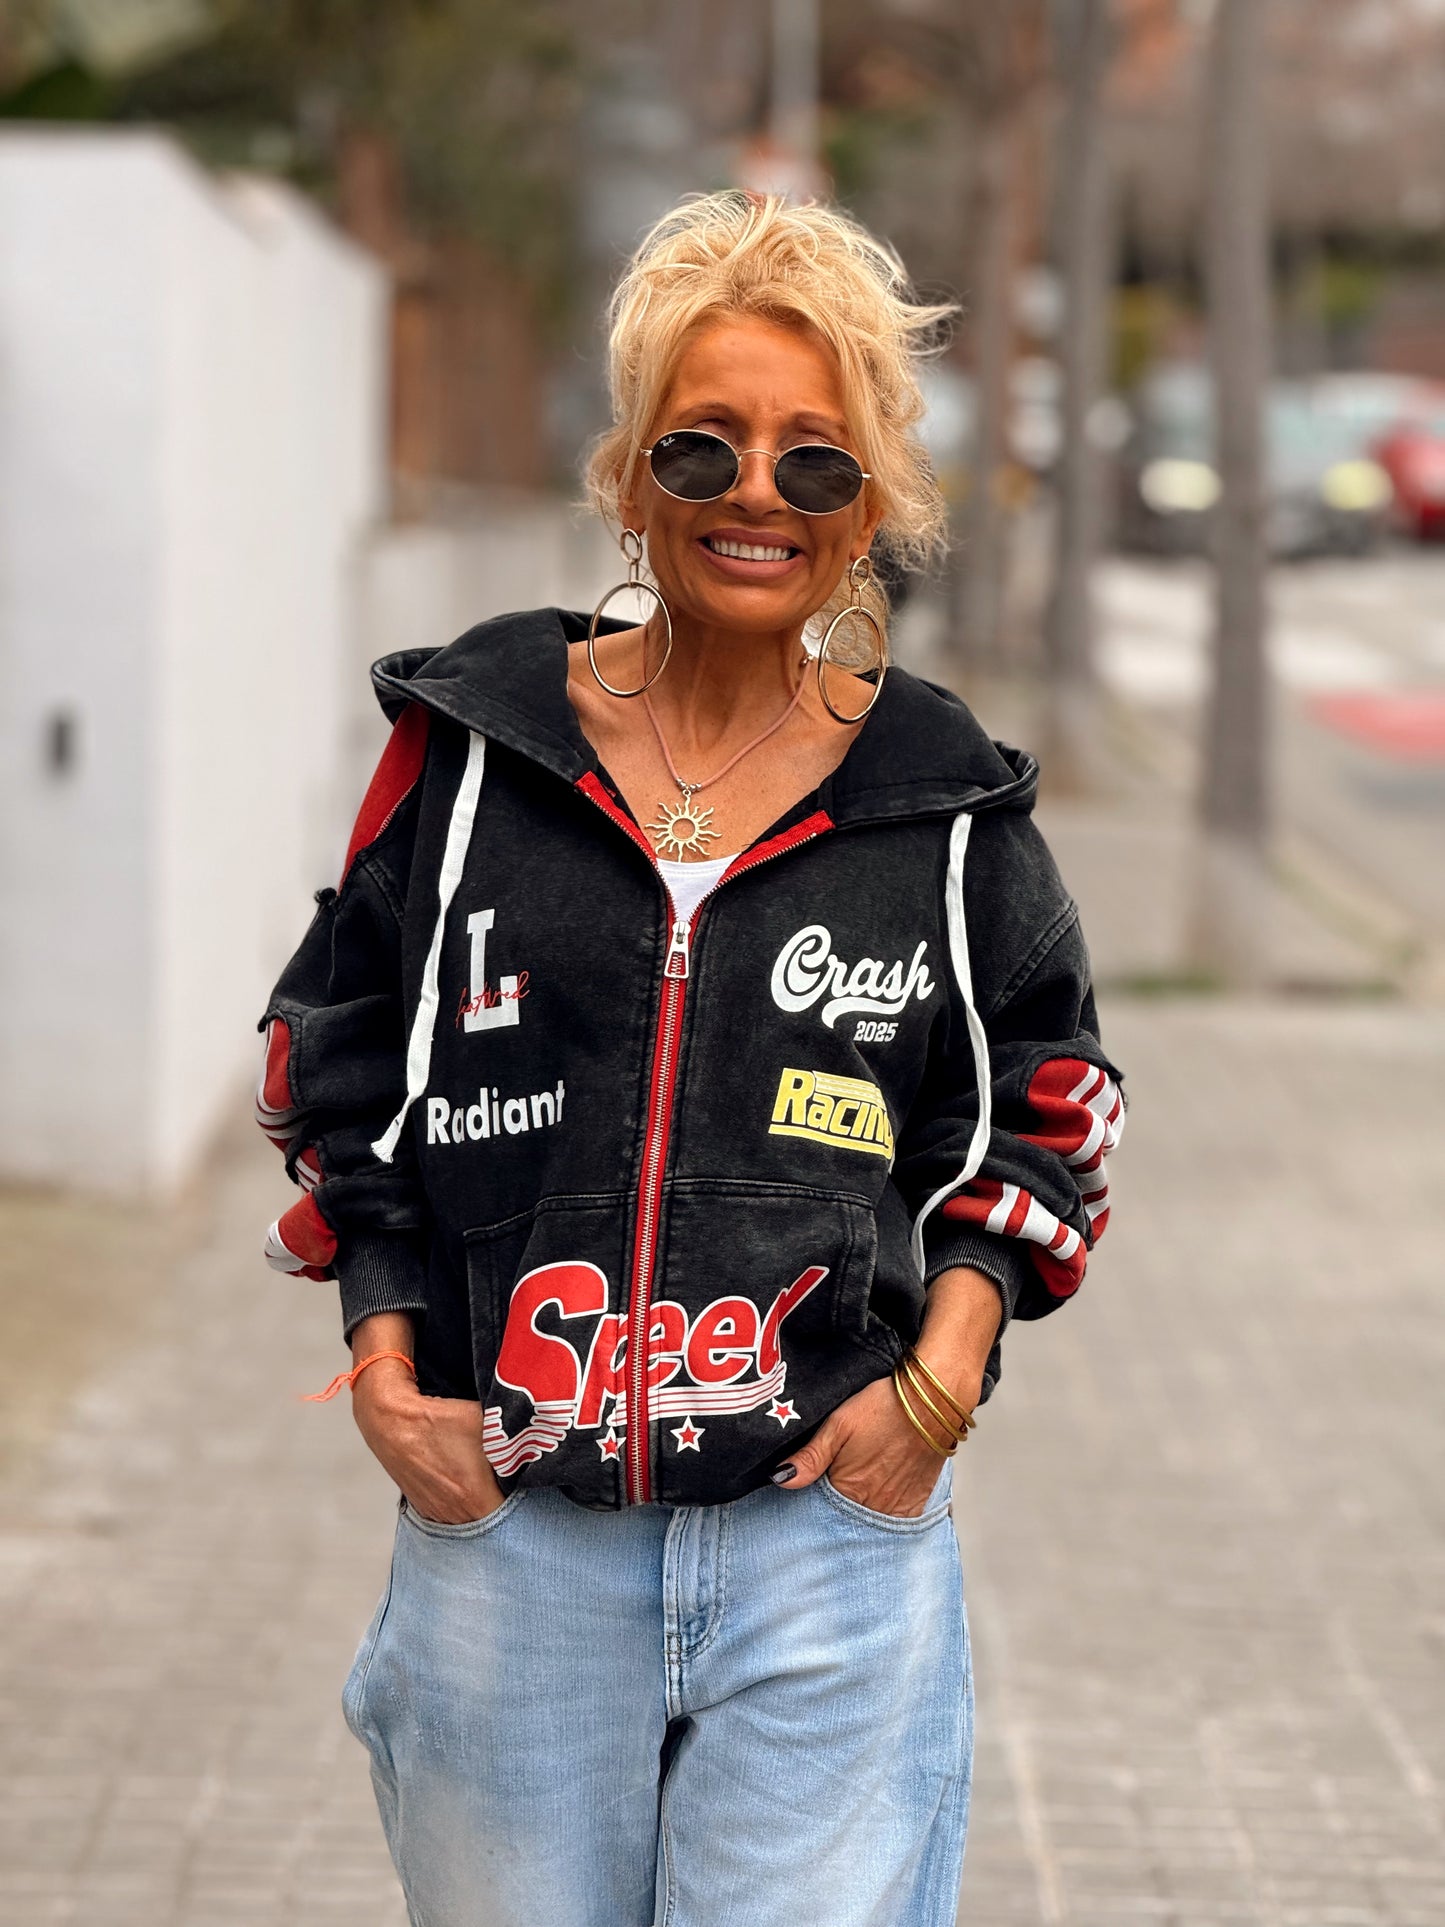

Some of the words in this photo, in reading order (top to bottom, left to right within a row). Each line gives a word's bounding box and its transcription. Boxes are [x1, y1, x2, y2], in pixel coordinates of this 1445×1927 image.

[466, 908, 519, 1033] L
[771, 924, 935, 1029] Crash
[853, 1020, 898, 1043] 2025
[427, 1079, 565, 1144] Radiant
